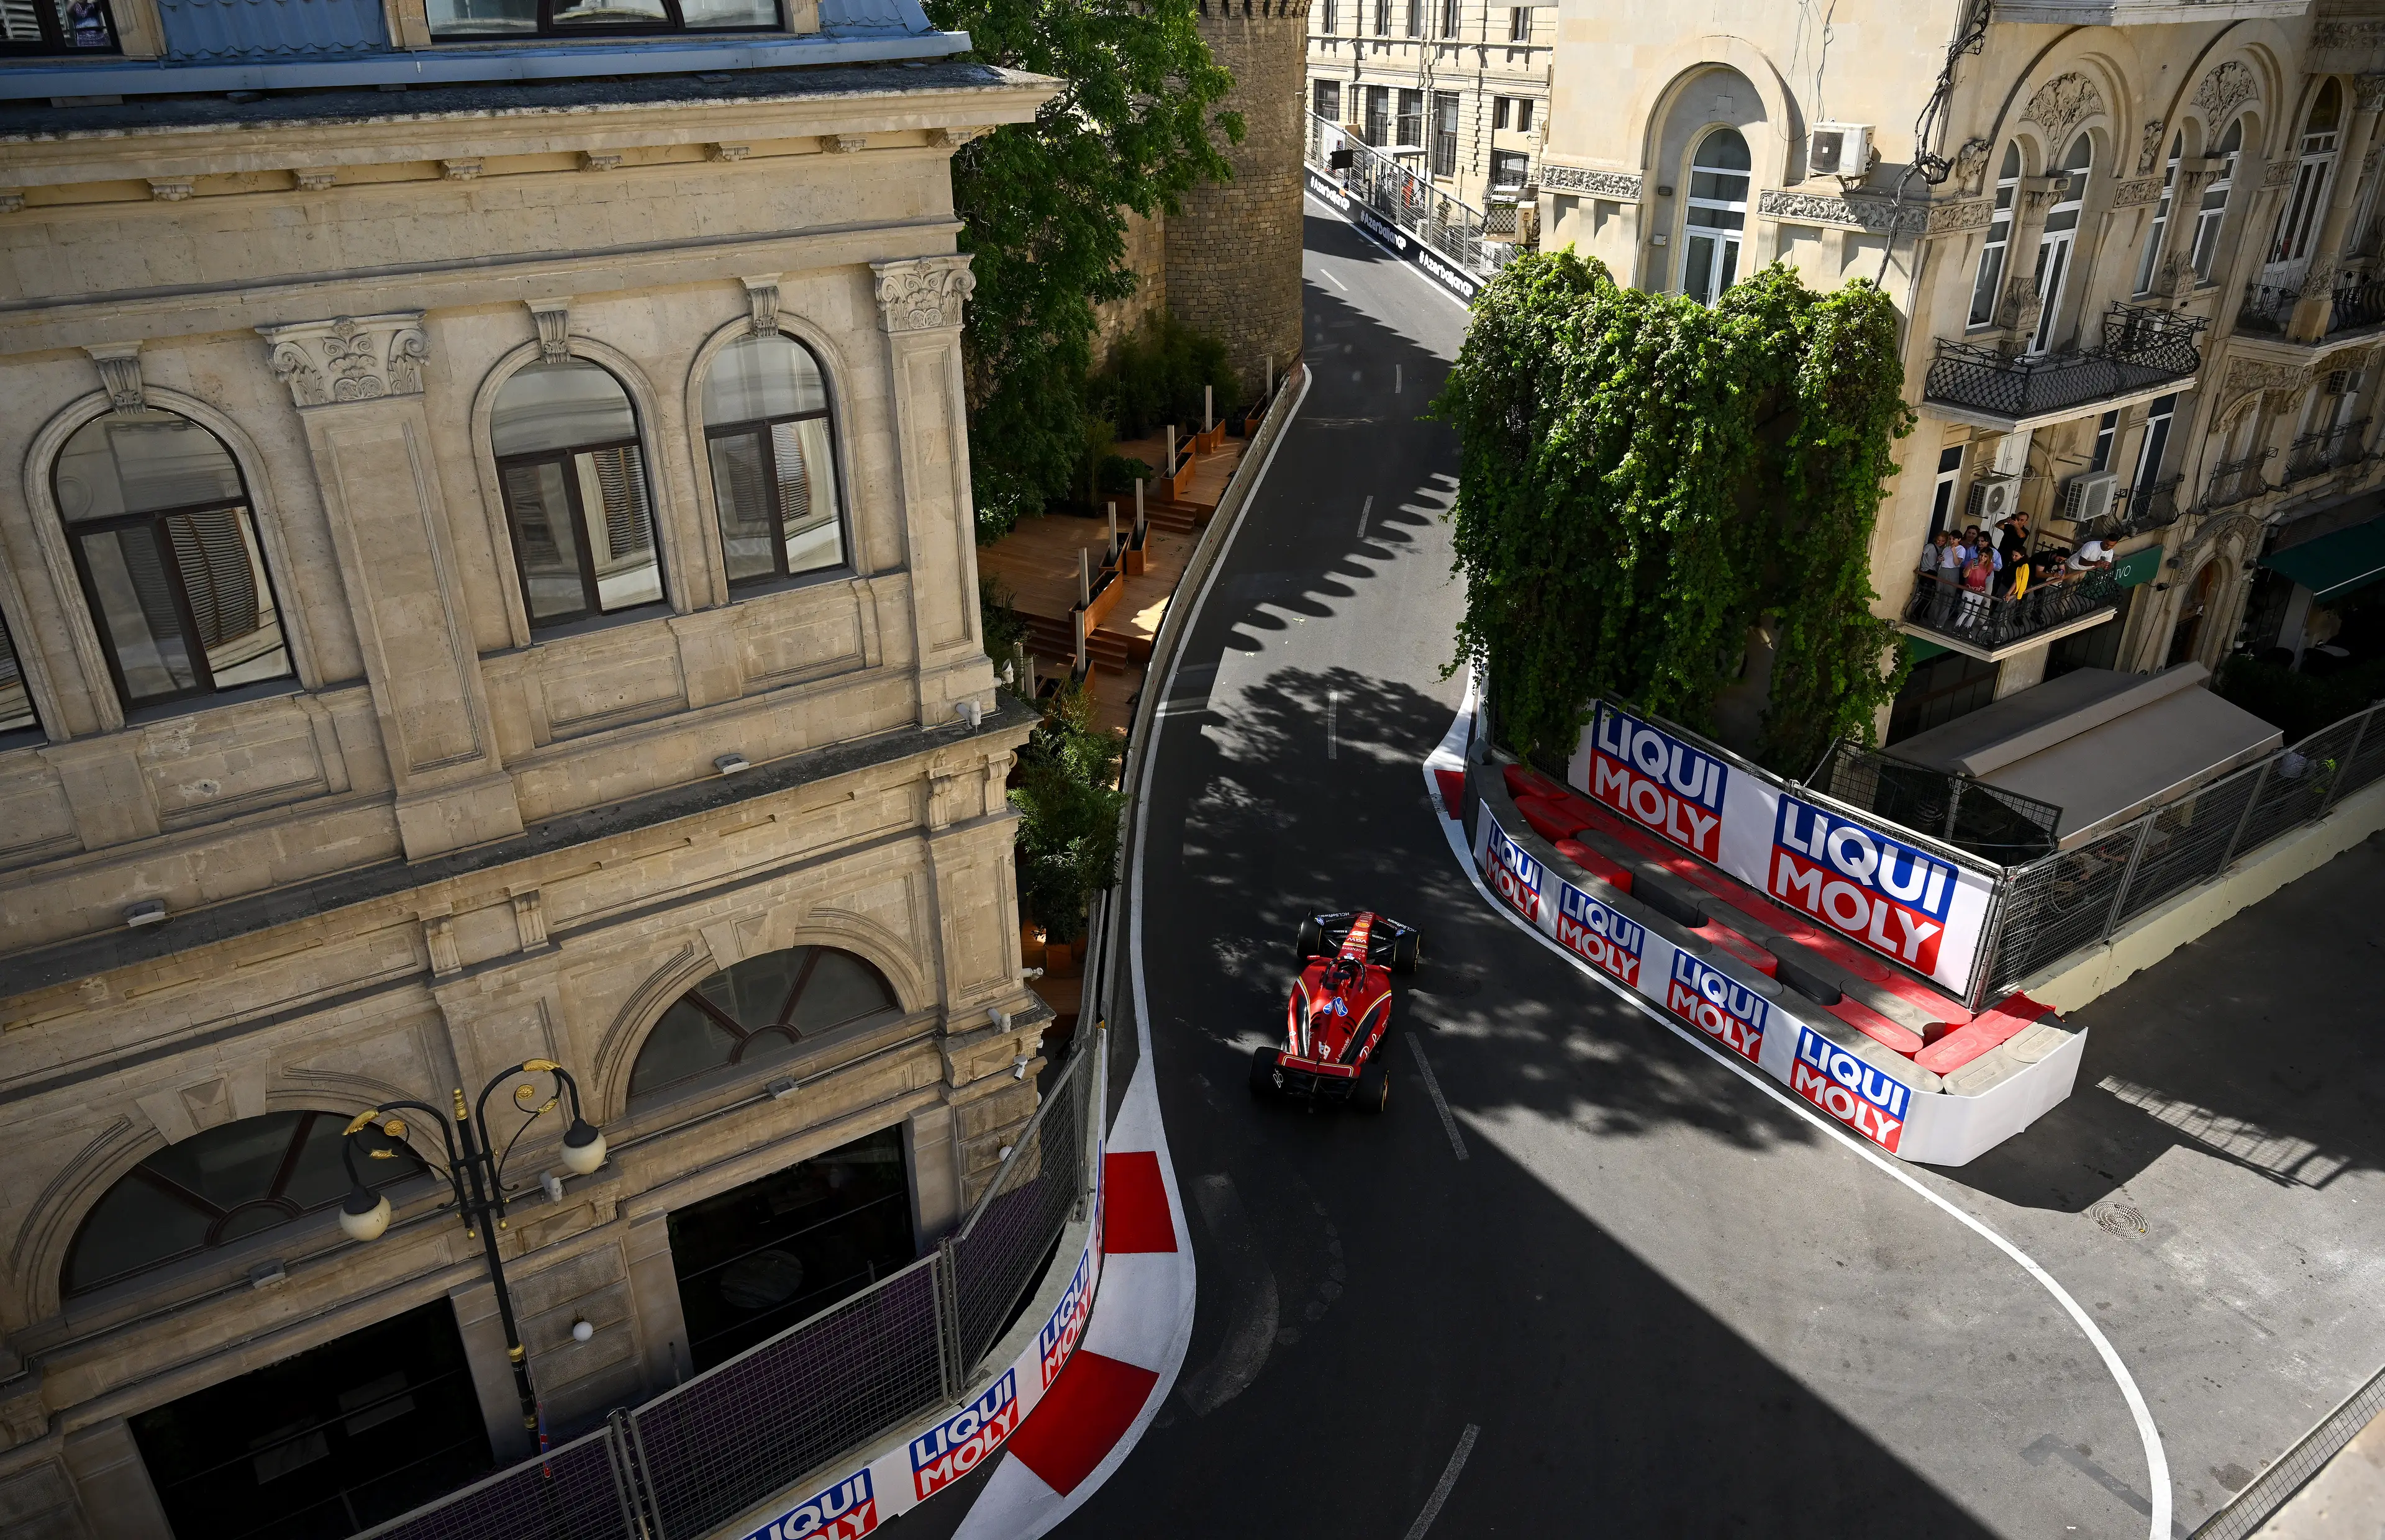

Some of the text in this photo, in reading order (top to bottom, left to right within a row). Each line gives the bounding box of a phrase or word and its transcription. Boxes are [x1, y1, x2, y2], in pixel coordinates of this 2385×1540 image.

[1597, 712, 1722, 808] LIQUI
[1594, 756, 1719, 852] MOLY
[1487, 851, 1538, 919] MOLY
[1490, 822, 1541, 886] LIQUI
[1781, 803, 1948, 914] LIQUI
[1560, 916, 1638, 981] MOLY
[1563, 887, 1641, 955] LIQUI
[1776, 853, 1940, 962] MOLY
[1671, 986, 1761, 1056] MOLY
[1676, 954, 1765, 1028] LIQUI
[1796, 1061, 1901, 1147] MOLY
[1801, 1032, 1906, 1116] LIQUI
[1042, 1254, 1088, 1356] LIQUI
[1045, 1284, 1091, 1384] MOLY
[915, 1378, 1012, 1465] LIQUI
[920, 1400, 1017, 1497] MOLY
[748, 1474, 867, 1540] IQUI
